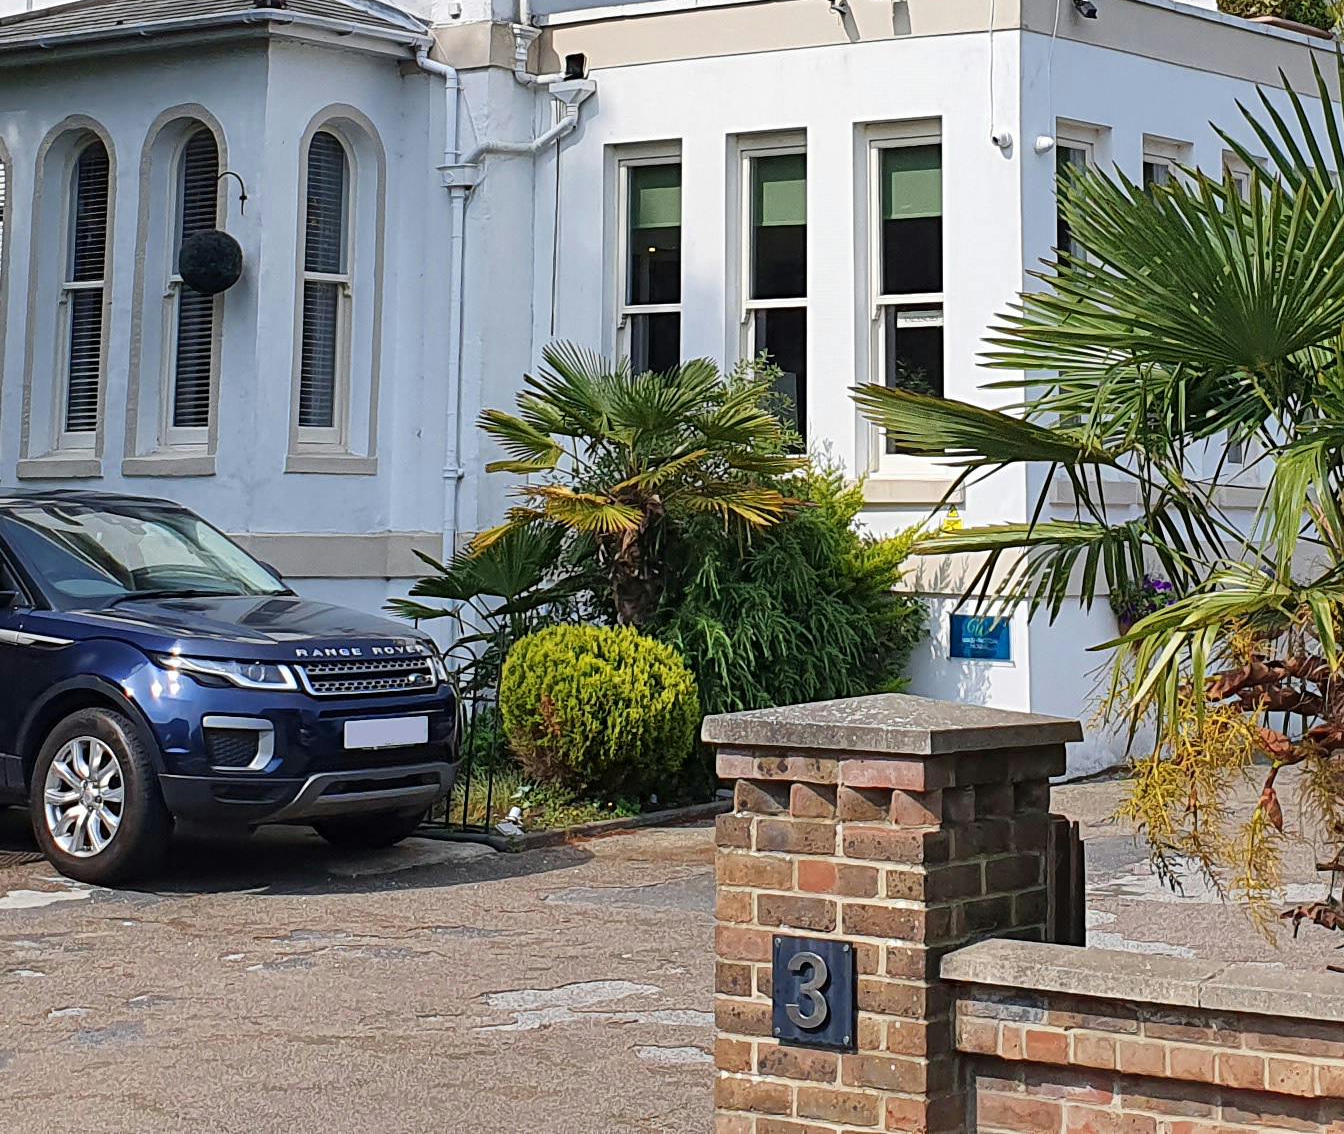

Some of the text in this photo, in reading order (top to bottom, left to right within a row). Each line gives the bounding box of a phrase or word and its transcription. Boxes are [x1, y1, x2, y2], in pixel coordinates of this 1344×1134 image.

[295, 644, 425, 657] RANGE ROVER
[786, 951, 828, 1029] 3
